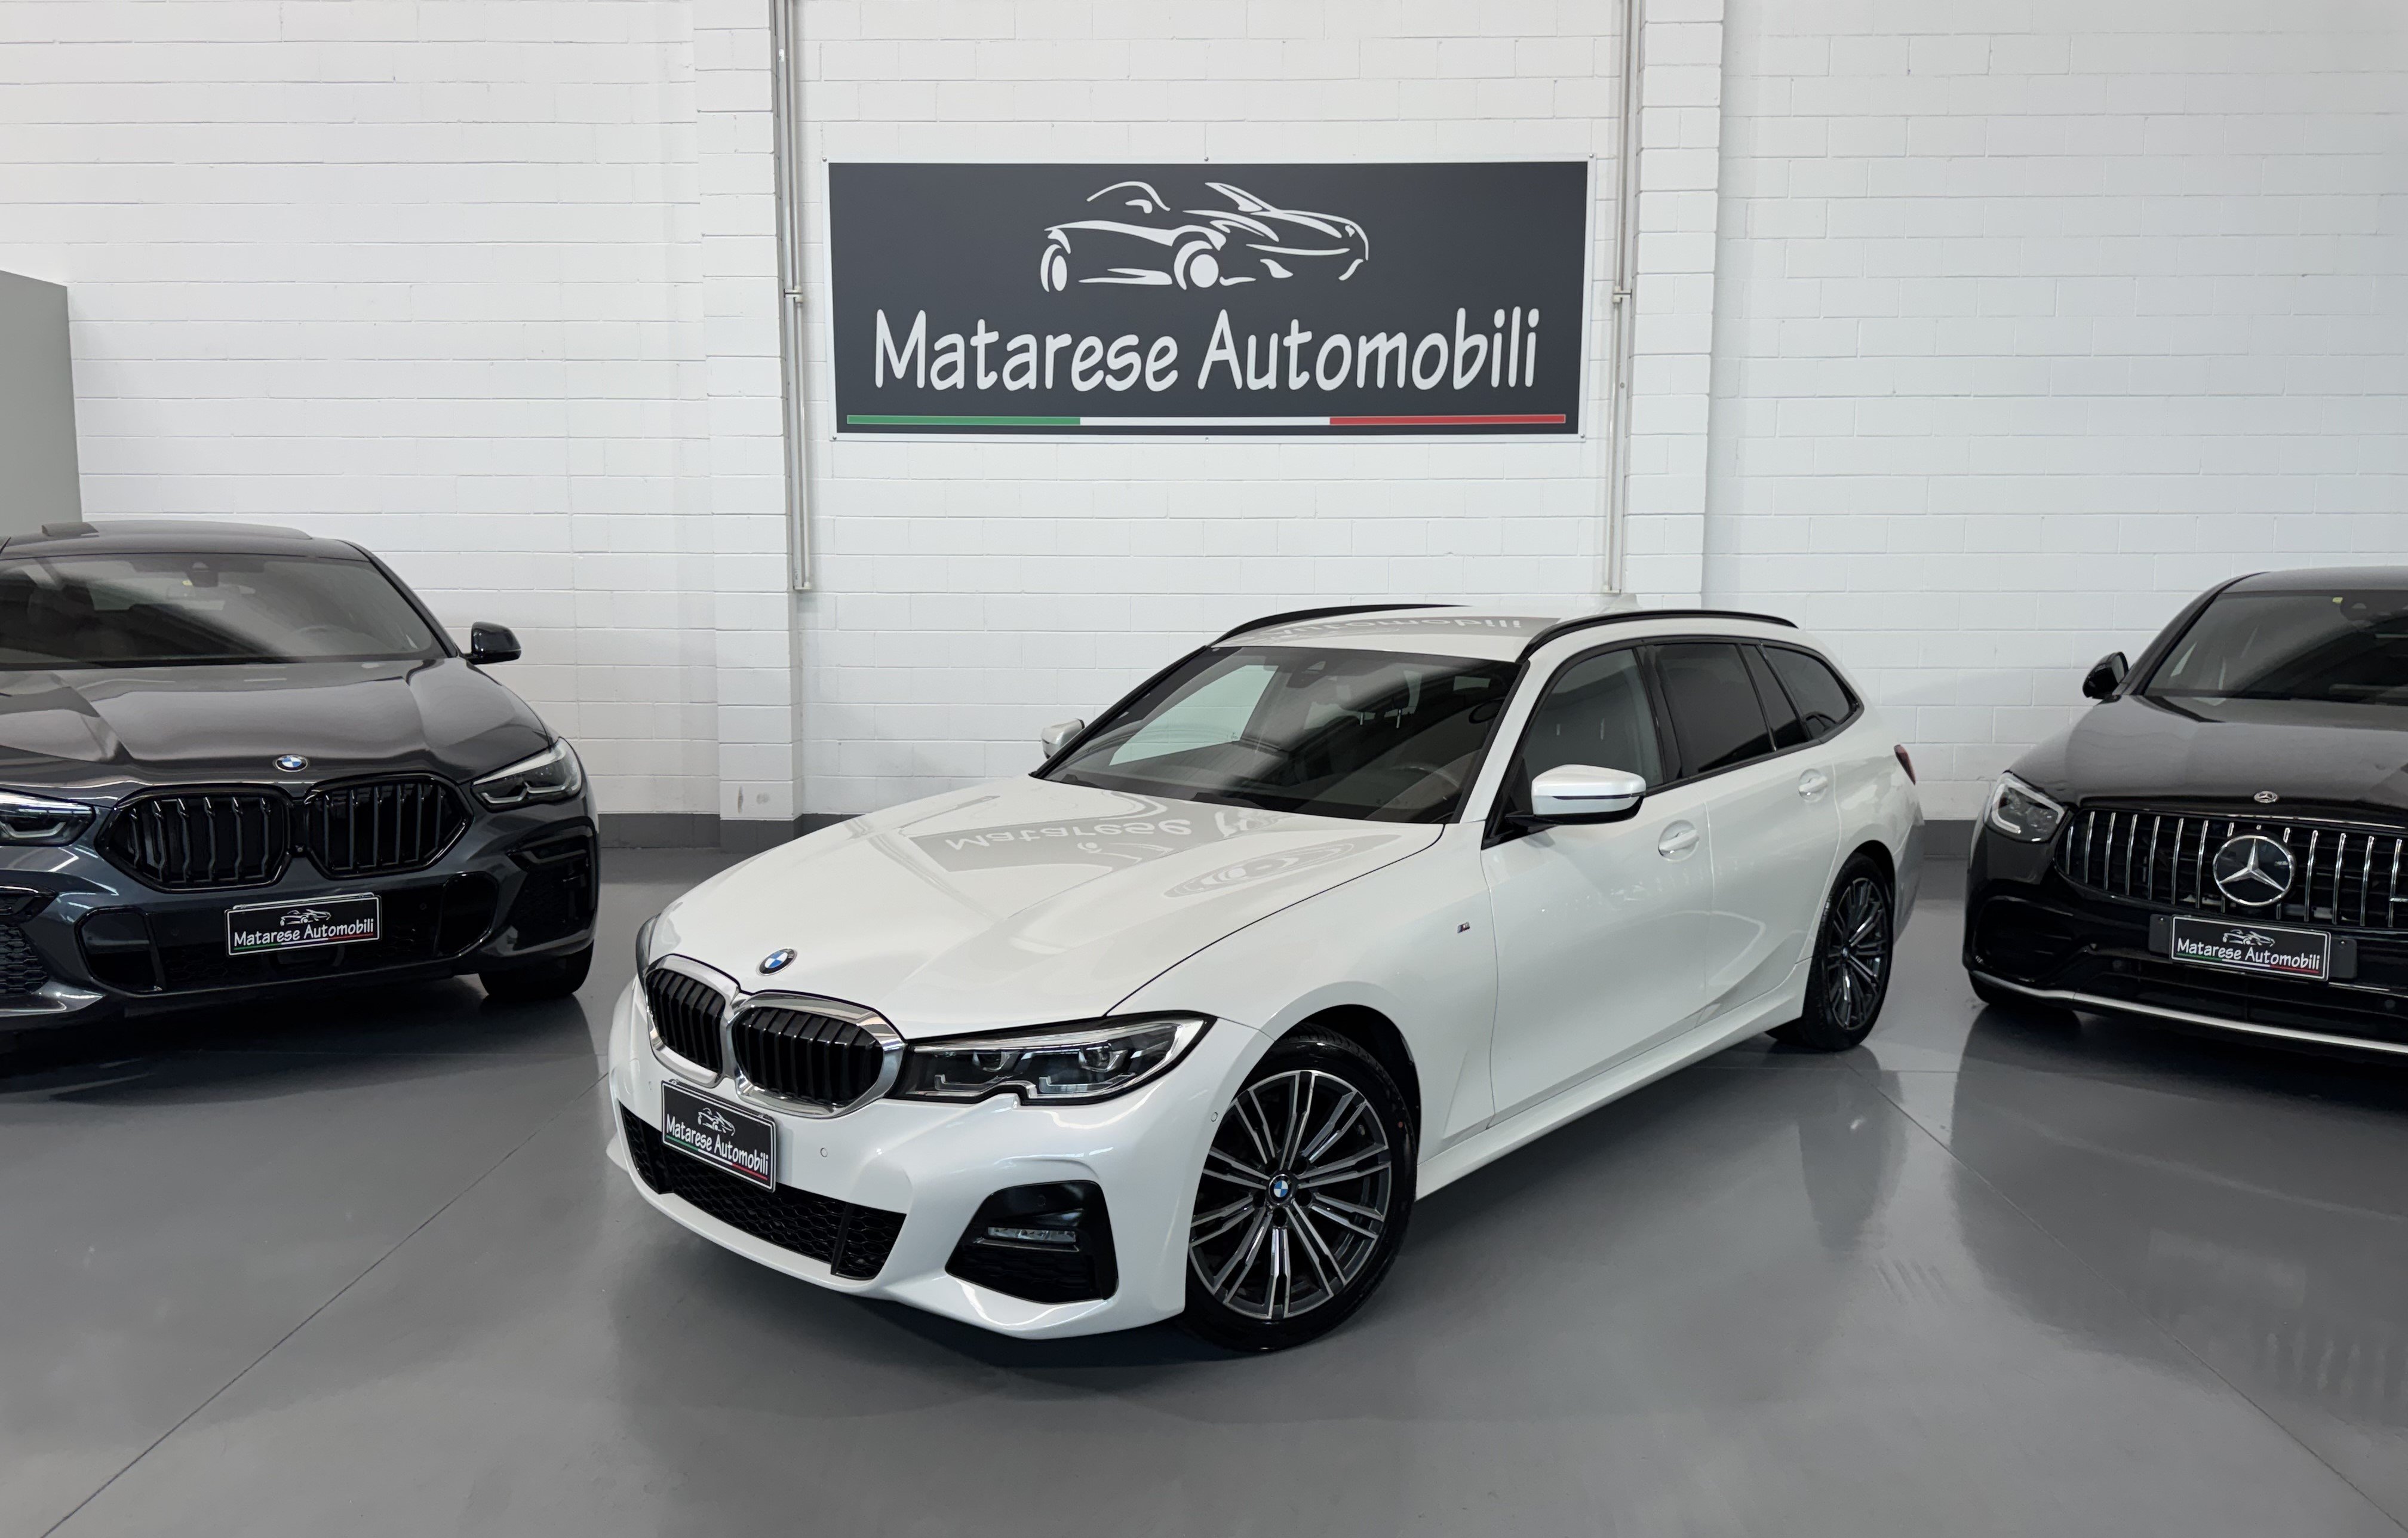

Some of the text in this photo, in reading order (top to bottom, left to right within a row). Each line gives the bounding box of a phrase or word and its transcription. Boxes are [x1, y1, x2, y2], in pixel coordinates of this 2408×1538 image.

[874, 306, 1540, 392] Matarese Automobili
[234, 918, 374, 947] Matarese Automobili
[2176, 937, 2320, 970] Matarese Automobili
[666, 1113, 769, 1175] Matarese Automobili
